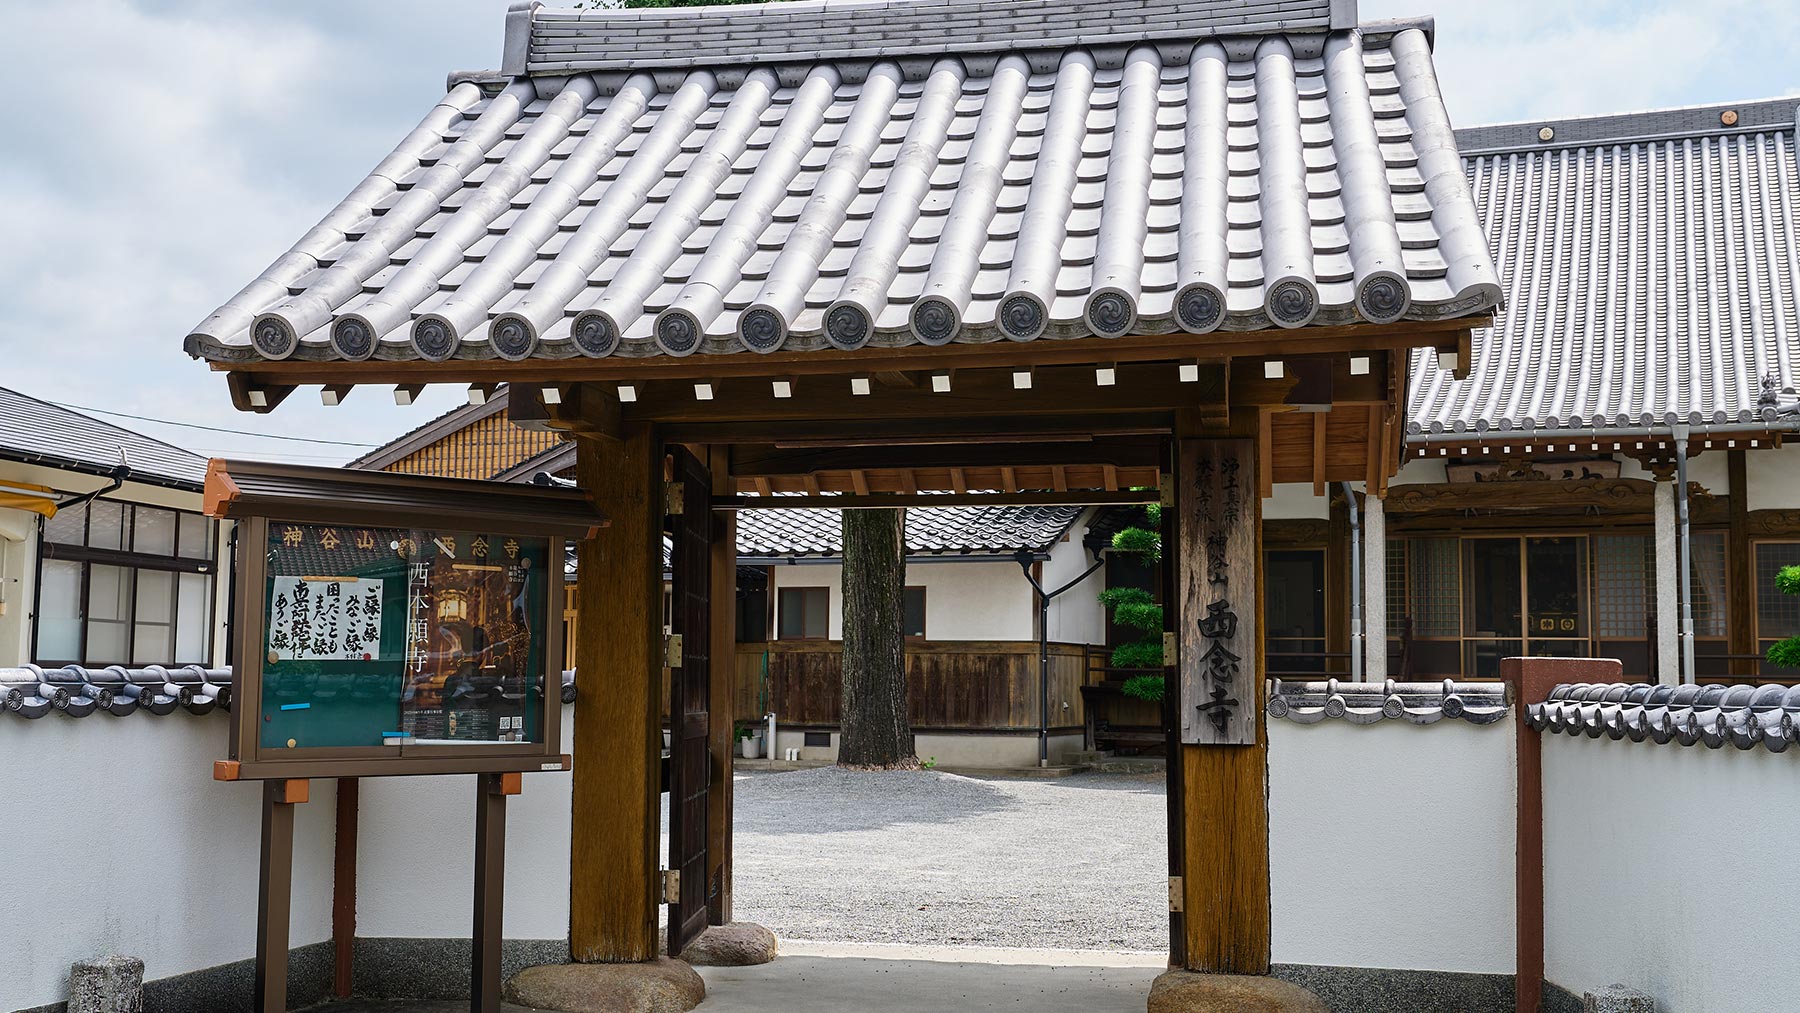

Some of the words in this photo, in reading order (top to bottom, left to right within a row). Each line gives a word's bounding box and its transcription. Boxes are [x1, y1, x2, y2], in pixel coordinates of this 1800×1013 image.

[283, 525, 375, 550] 神谷山
[311, 593, 328, 656] またご縁
[326, 582, 341, 654] 困ったことも
[343, 594, 364, 652] みなご縁
[363, 585, 381, 643] ご縁ご縁
[406, 562, 430, 673] 西本願寺
[1196, 600, 1242, 735] 西念寺
